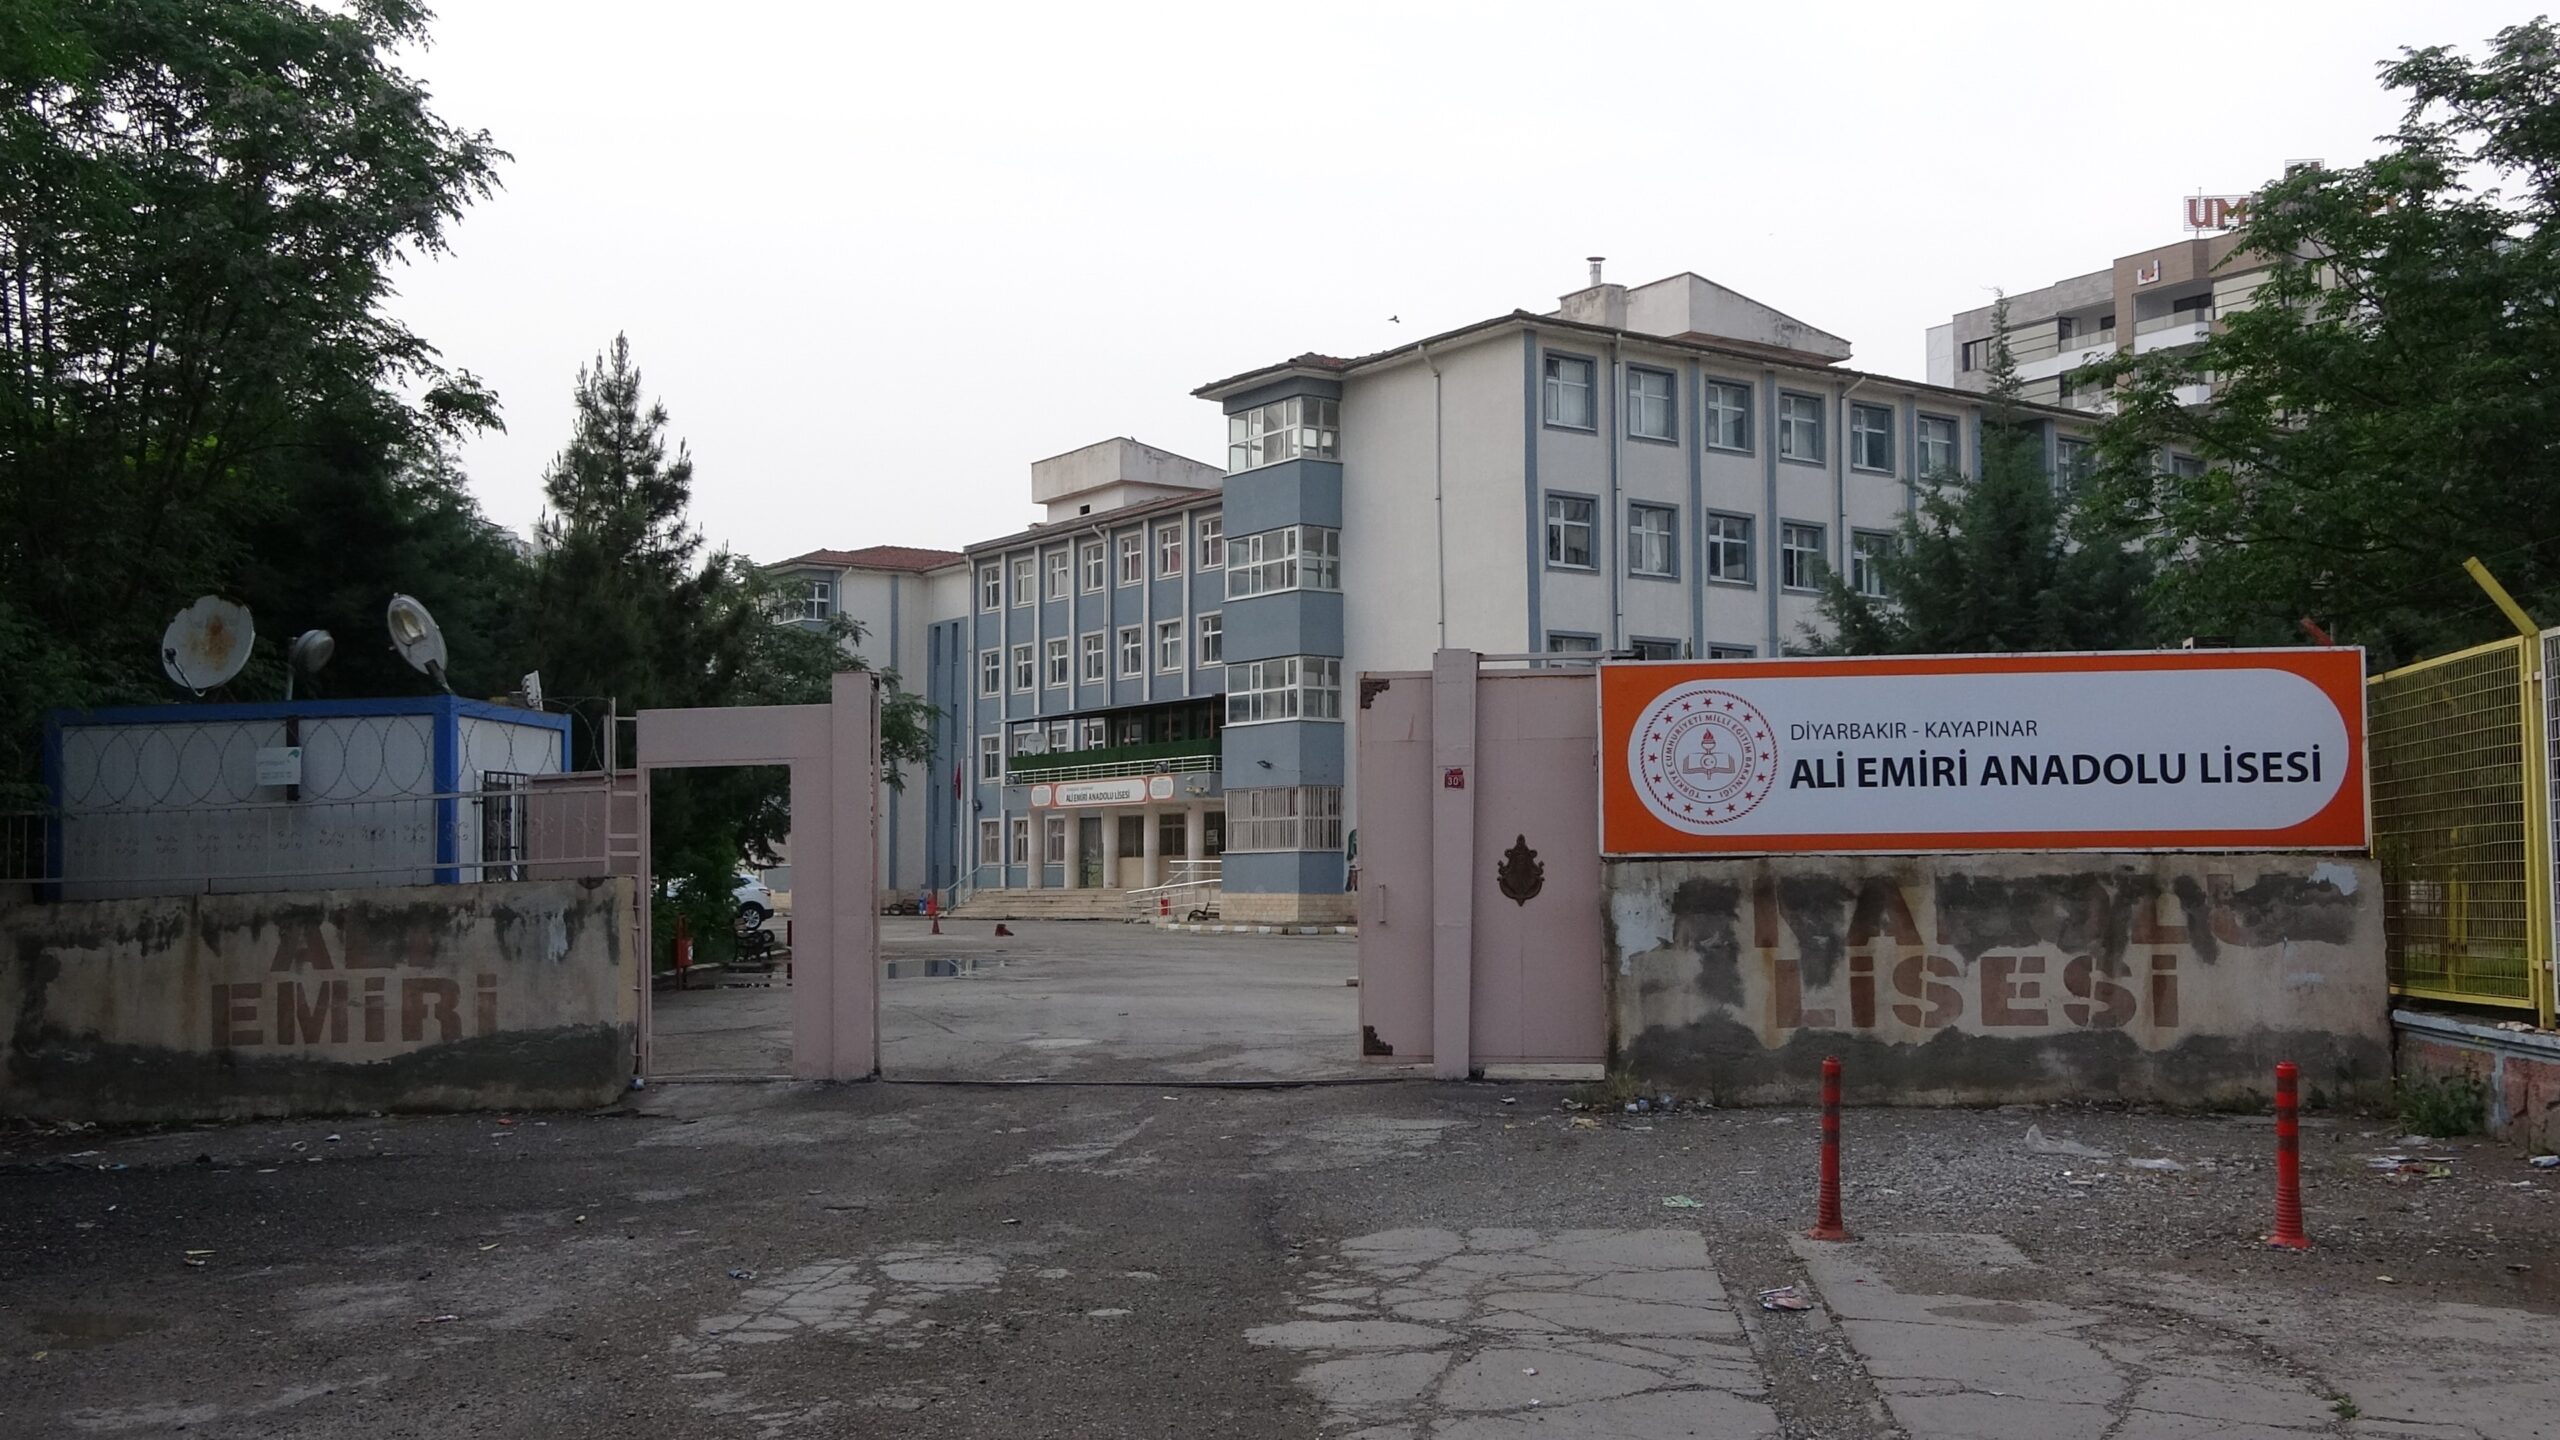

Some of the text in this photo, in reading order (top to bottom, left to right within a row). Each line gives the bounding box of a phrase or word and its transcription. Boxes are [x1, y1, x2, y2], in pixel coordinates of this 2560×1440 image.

[1791, 721, 1907, 741] DİYARBAKIR
[1925, 720, 2038, 738] KAYAPINAR
[1789, 744, 2321, 789] ALİ EMİRİ ANADOLU LİSESİ
[1089, 791, 1114, 801] ANADOLU
[1774, 953, 2179, 1029] LİSESİ
